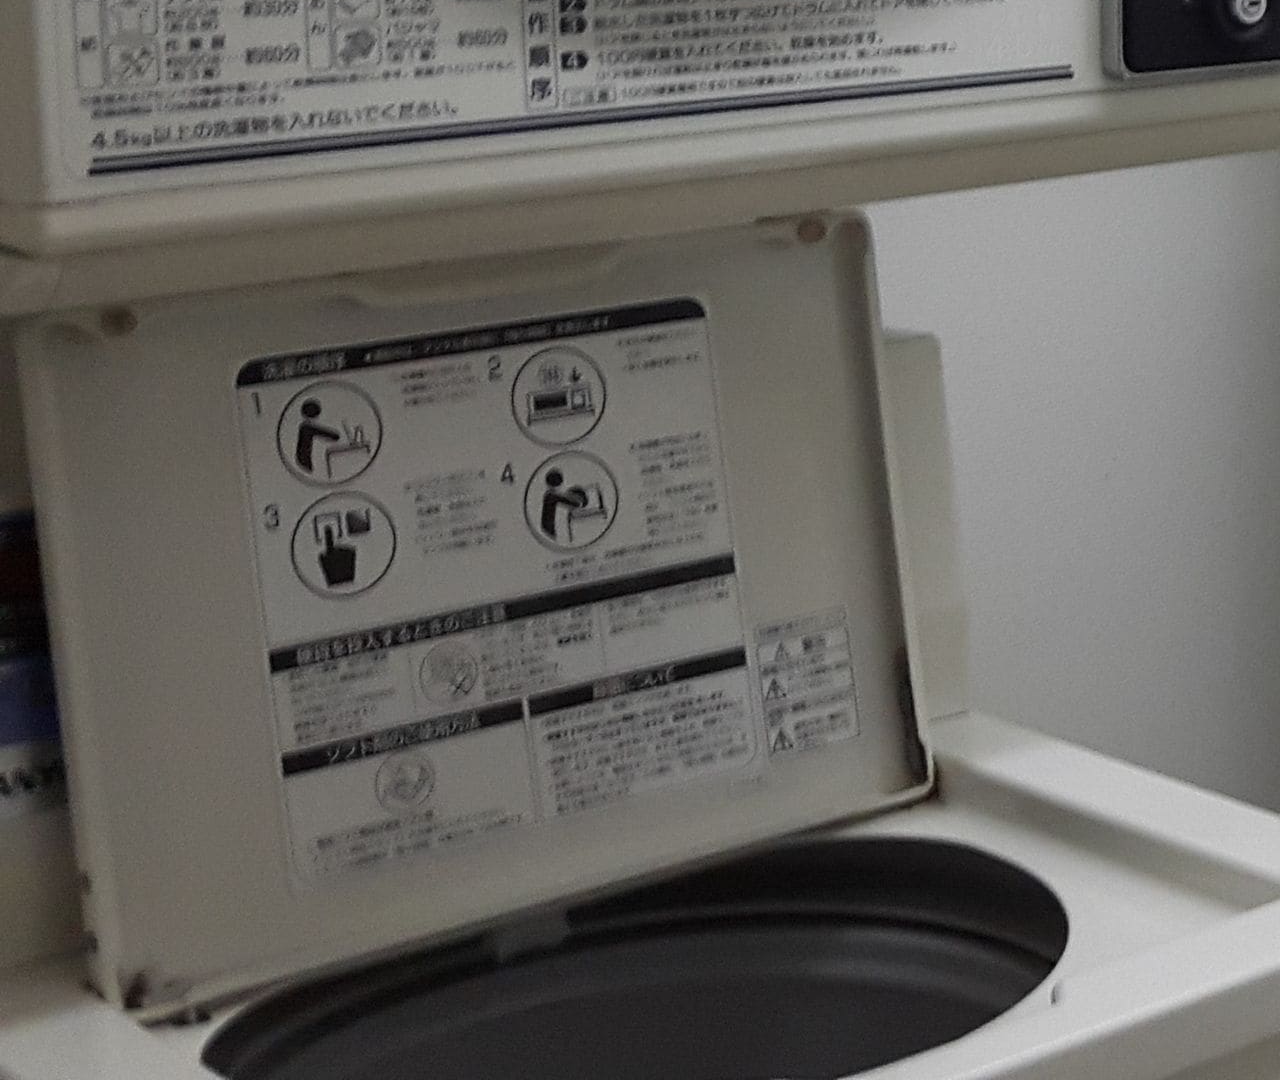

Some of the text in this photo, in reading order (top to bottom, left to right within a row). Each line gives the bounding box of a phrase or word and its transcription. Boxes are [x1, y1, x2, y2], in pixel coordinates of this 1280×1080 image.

[488, 355, 502, 382] 2
[251, 392, 262, 415] 1
[500, 463, 514, 484] 4
[263, 504, 280, 529] 3
